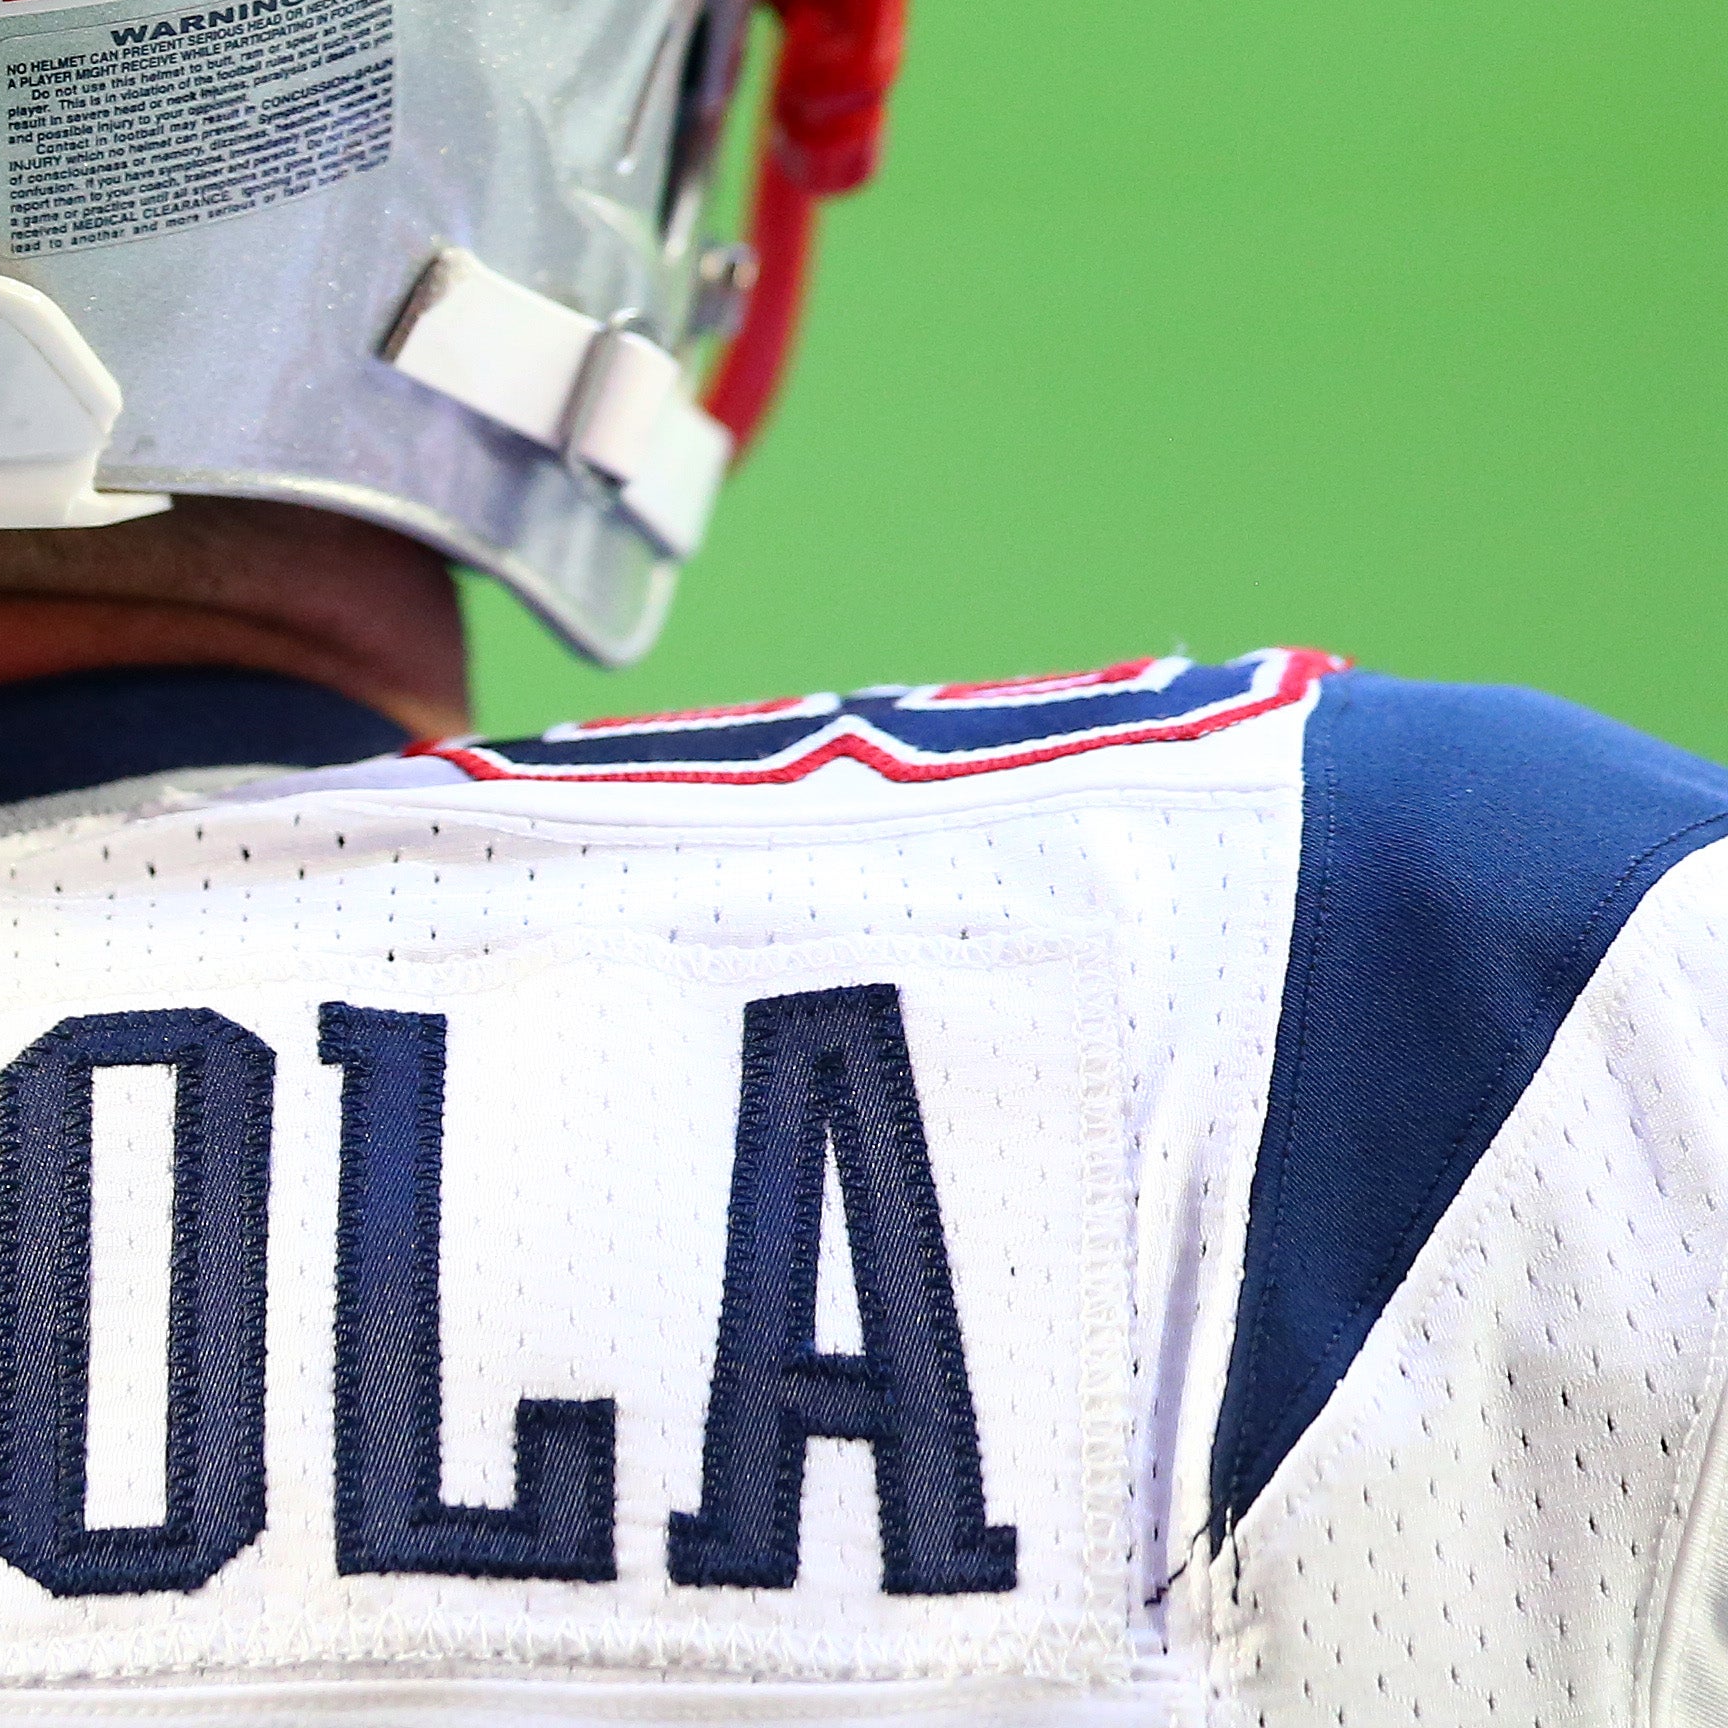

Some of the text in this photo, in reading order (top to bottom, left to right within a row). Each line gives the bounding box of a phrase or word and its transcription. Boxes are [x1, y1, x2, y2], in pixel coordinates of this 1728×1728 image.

[6, 64, 26, 75] NO
[31, 55, 85, 71] HELMET
[90, 50, 118, 63] CAN
[123, 37, 183, 57] PREVENT
[187, 24, 243, 45] SERIOUS
[247, 13, 282, 31] HEAD
[7, 79, 17, 89] A
[20, 71, 71, 87] PLAYER
[75, 63, 117, 79] MIGHT
[121, 52, 177, 71] RECEIVE
[182, 43, 220, 60] WHILE
[224, 18, 313, 51] PARTICIPATING
[32, 89, 49, 99] Do
[55, 84, 77, 95] not
[82, 81, 105, 91] use
[111, 75, 136, 87] this
[141, 65, 184, 82] helmet
[189, 62, 201, 72] to
[240, 48, 263, 60] ram
[268, 44, 280, 53] or
[8, 116, 44, 130] result
[50, 114, 62, 124] in
[66, 108, 109, 121] severe
[114, 100, 145, 114] head
[149, 99, 161, 108] or
[167, 90, 197, 104] neck
[253, 63, 307, 87] paralysis
[58, 97, 85, 109] This
[90, 94, 100, 104] is
[105, 92, 115, 102] in
[120, 83, 173, 99] violation
[177, 77, 190, 88] of
[194, 74, 212, 85] the
[217, 60, 261, 80] football
[264, 53, 293, 68] rules
[8, 131, 32, 144] and
[37, 124, 93, 142] possible
[97, 118, 134, 131] injury
[138, 114, 150, 123] to
[155, 108, 183, 123] your
[9, 155, 62, 171] INJURY
[65, 148, 103, 163] which
[108, 147, 124, 156] no
[128, 136, 171, 153] helmet
[175, 133, 197, 144] can
[36, 137, 89, 153] Contact
[95, 135, 106, 145] in
[114, 124, 163, 142] football
[170, 119, 196, 131] may
[202, 107, 239, 124] result
[244, 104, 255, 114] in
[9, 174, 21, 185] of
[27, 160, 127, 182] consciousness
[132, 157, 145, 166] or
[10, 198, 48, 213] report
[53, 195, 84, 206] them
[90, 191, 101, 200] to
[105, 186, 135, 200] your
[184, 167, 223, 183] trainer
[227, 158, 249, 172] and
[85, 177, 93, 188] If
[97, 175, 120, 188] you
[125, 169, 154, 181] have
[229, 132, 299, 158] immediately
[10, 218, 17, 226] a
[23, 213, 58, 226] game
[64, 210, 77, 218] or
[84, 200, 134, 218] practice
[139, 191, 167, 206] until
[173, 187, 187, 199] all
[192, 172, 255, 195] symptoms
[261, 166, 278, 177] are
[11, 223, 67, 240] received
[72, 211, 137, 231] MEDICAL
[242, 175, 291, 196] Ignoring
[11, 241, 39, 253] lead
[49, 238, 61, 248] to
[70, 230, 124, 245] another
[133, 221, 157, 234] and
[165, 214, 198, 228] more
[207, 200, 255, 218] serious
[263, 194, 275, 204] or
